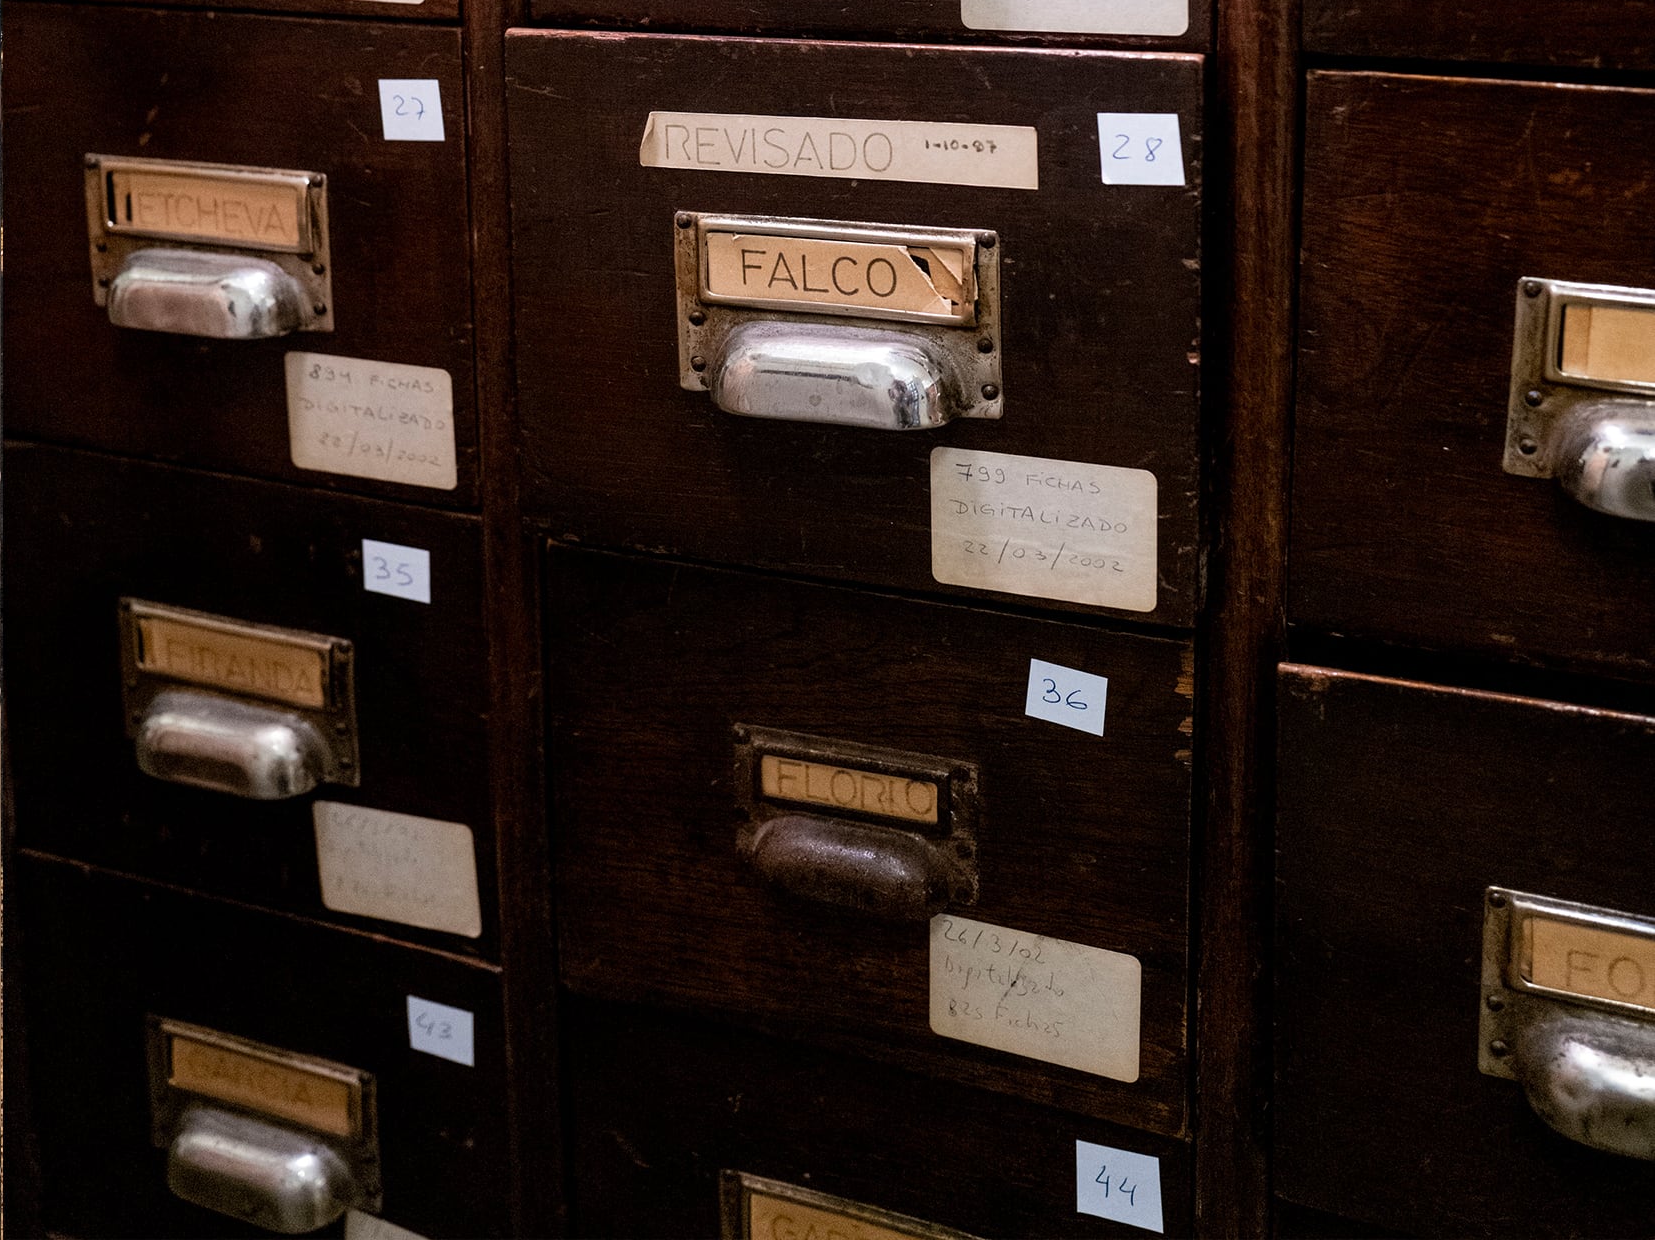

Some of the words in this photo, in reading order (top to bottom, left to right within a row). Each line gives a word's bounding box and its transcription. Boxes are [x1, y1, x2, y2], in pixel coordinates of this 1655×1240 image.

[392, 93, 427, 122] 27
[663, 122, 894, 173] REVISADO
[1111, 133, 1163, 163] 28
[137, 191, 288, 238] ETCHEVA
[741, 248, 899, 299] FALCO
[954, 462, 1006, 485] 799
[371, 555, 414, 587] 35
[962, 538, 1126, 574] 22/03/2002
[1041, 676, 1089, 712] 36
[777, 759, 936, 817] FLORIO
[1093, 1163, 1138, 1208] 44
